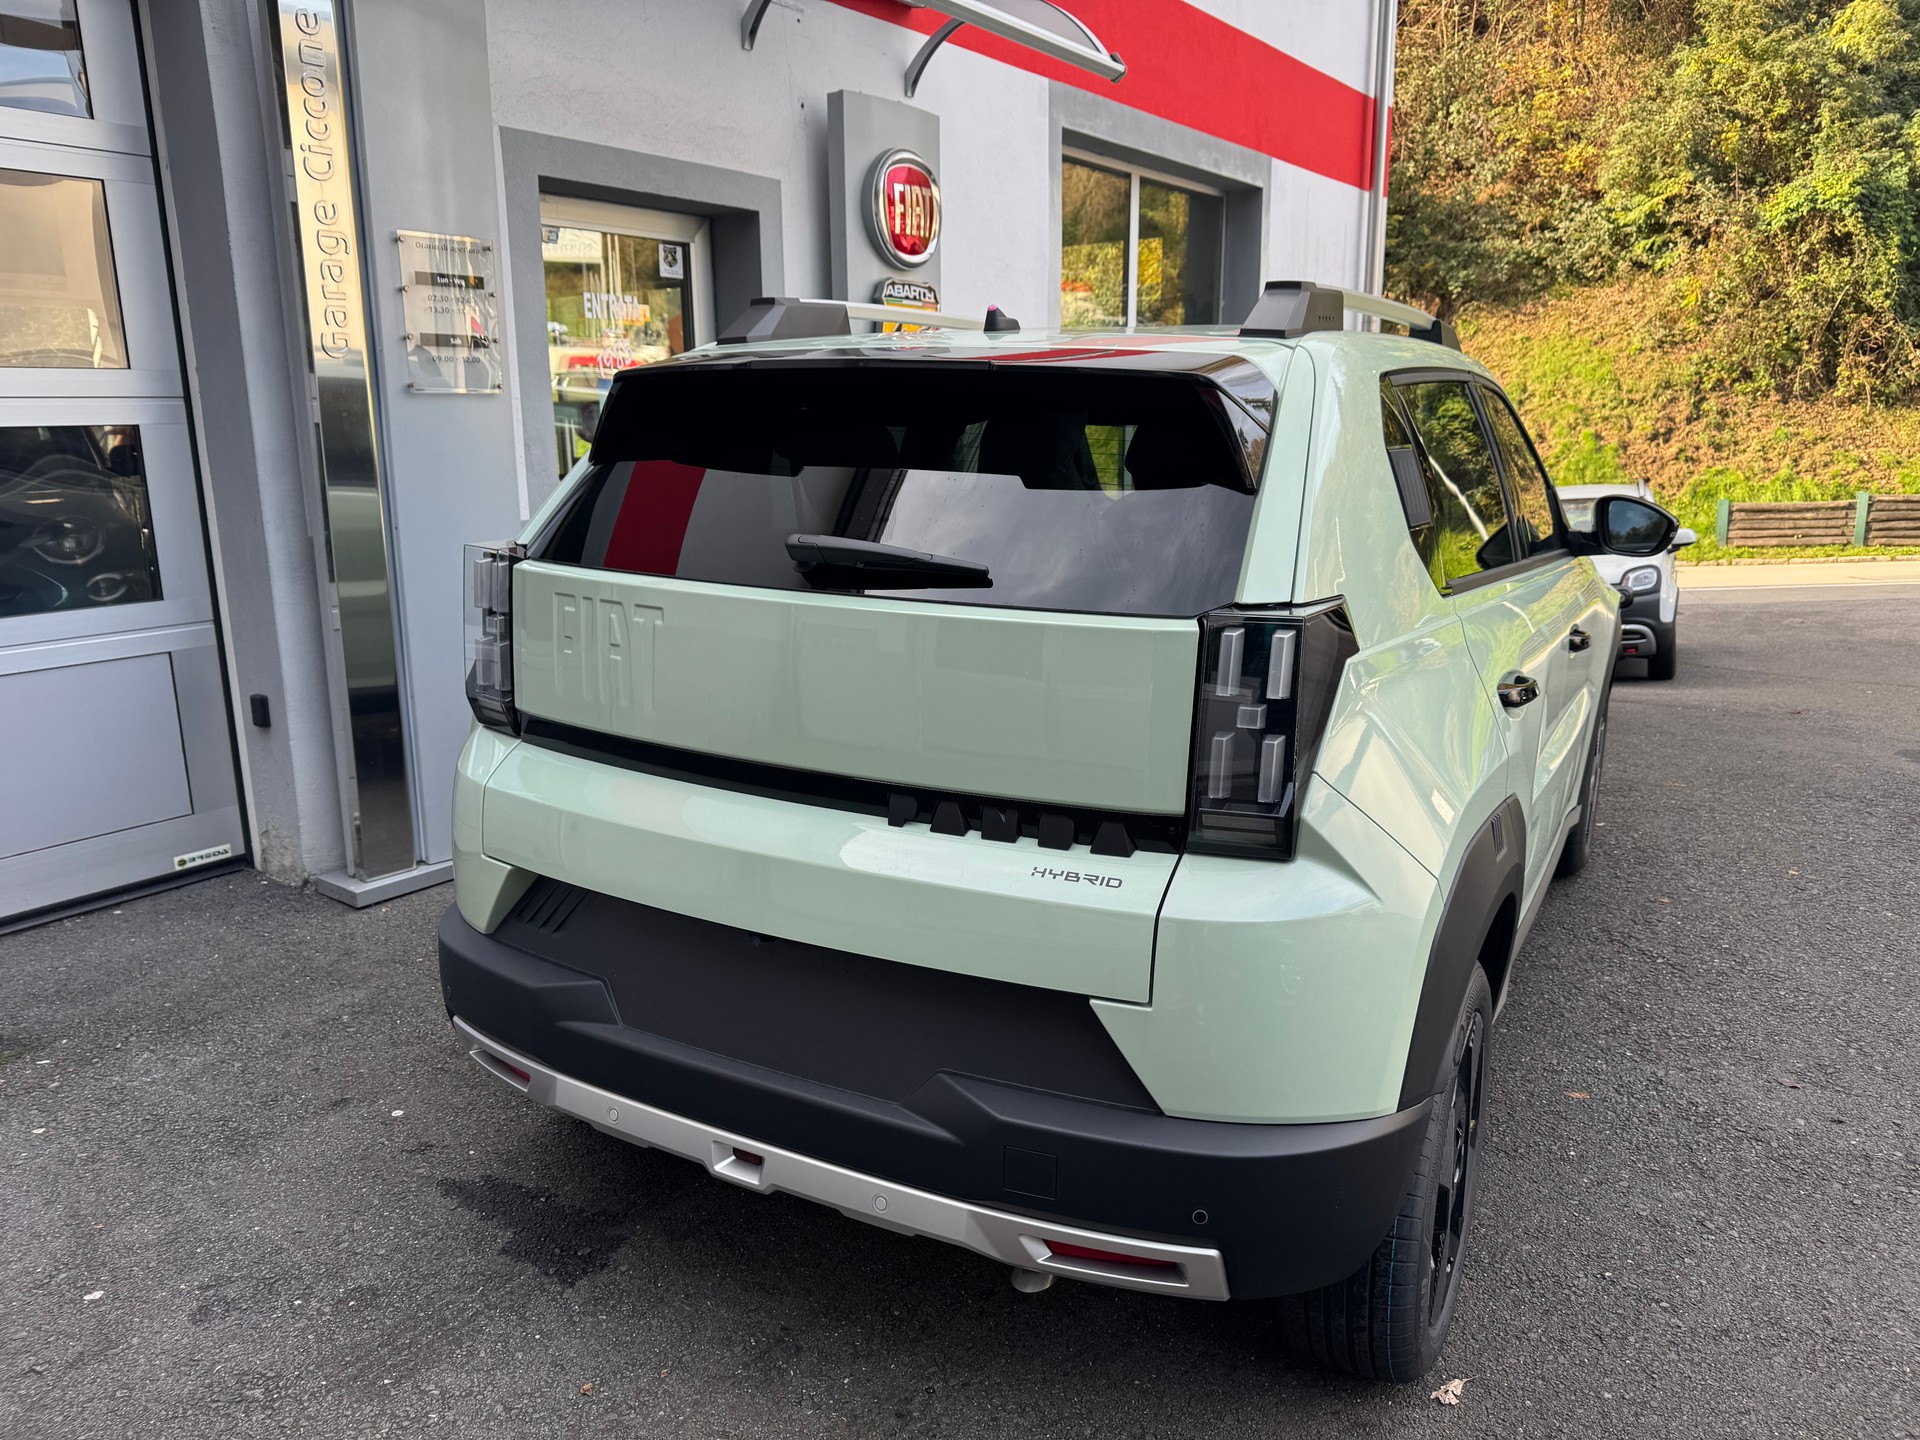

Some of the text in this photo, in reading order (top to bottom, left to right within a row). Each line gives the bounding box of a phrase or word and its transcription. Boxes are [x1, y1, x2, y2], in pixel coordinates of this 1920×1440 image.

[295, 7, 350, 360] Garage Ciccone
[893, 182, 932, 238] FIAT
[415, 241, 439, 251] Orario
[450, 246, 480, 255] apertura
[437, 276, 449, 284] Lun
[427, 294, 449, 303] 07.30
[886, 283, 936, 302] ABARTH
[429, 306, 450, 314] 13.30
[583, 292, 641, 321] ENTRATA
[450, 337, 462, 345] Sab
[432, 355, 454, 363] 09.00
[462, 356, 481, 364] 12.00
[597, 339, 633, 379] 1985
[553, 591, 664, 712] FIAT
[887, 792, 1137, 858] PANDA
[1030, 866, 1123, 889] HYBRID
